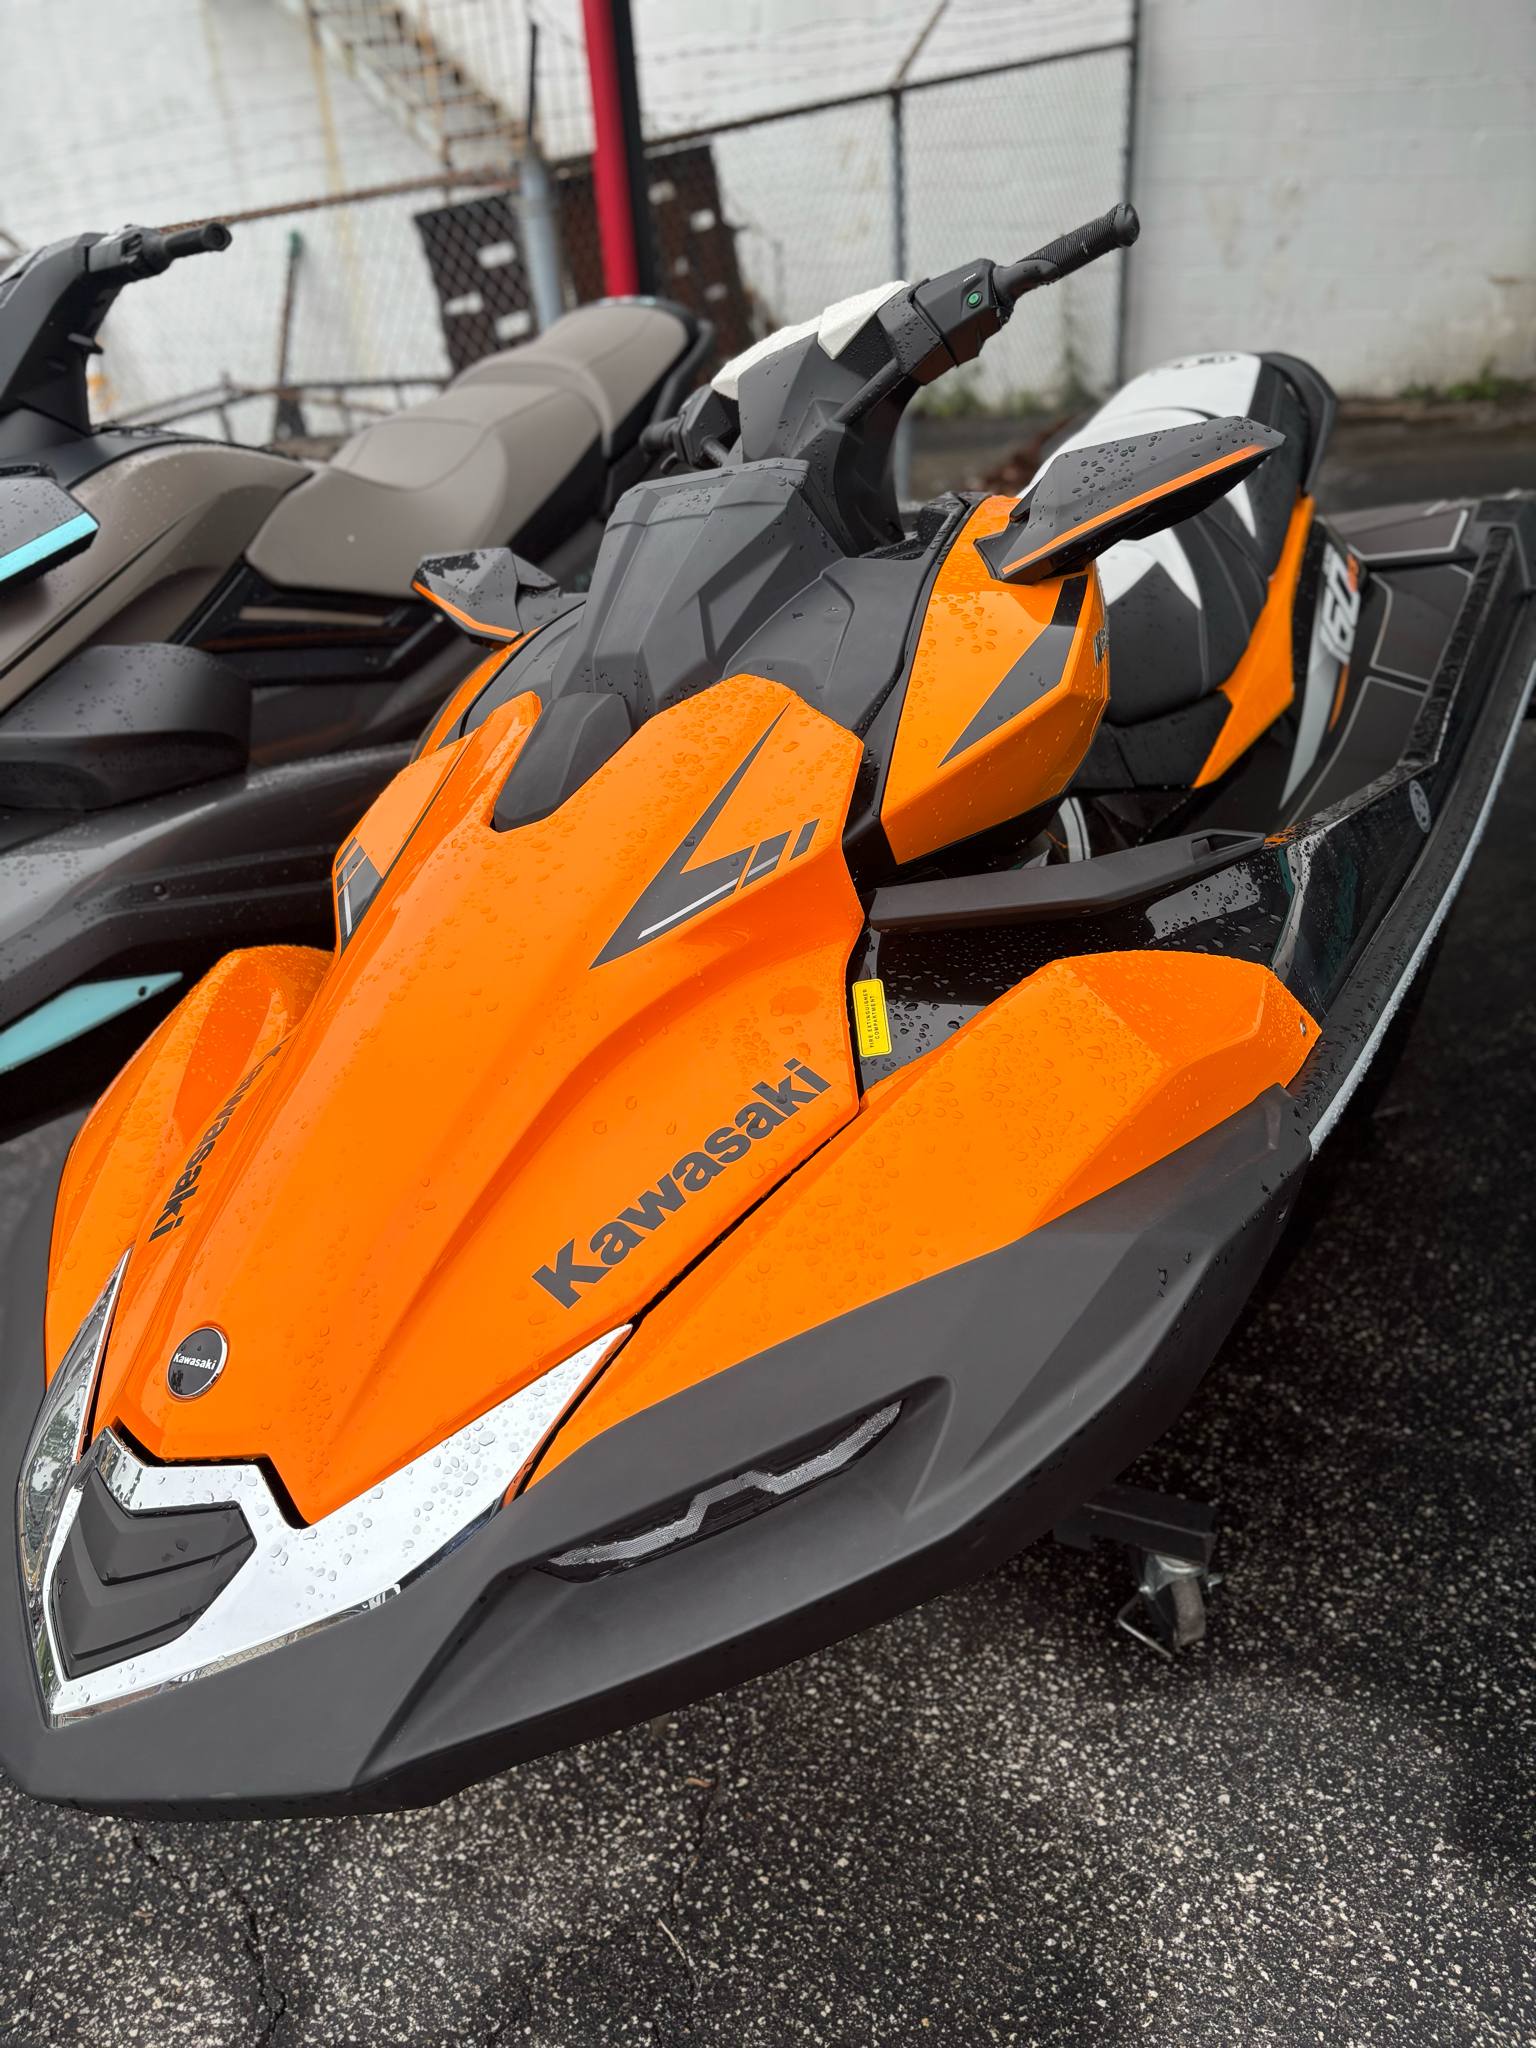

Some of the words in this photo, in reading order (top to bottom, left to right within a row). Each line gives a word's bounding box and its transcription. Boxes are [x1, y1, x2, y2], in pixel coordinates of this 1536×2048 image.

[862, 988, 872, 1032] EXTINGUISHER
[869, 995, 880, 1039] COMPARTMENT
[532, 1057, 832, 1309] Kawasaki
[173, 1352, 217, 1370] Kawasaki
